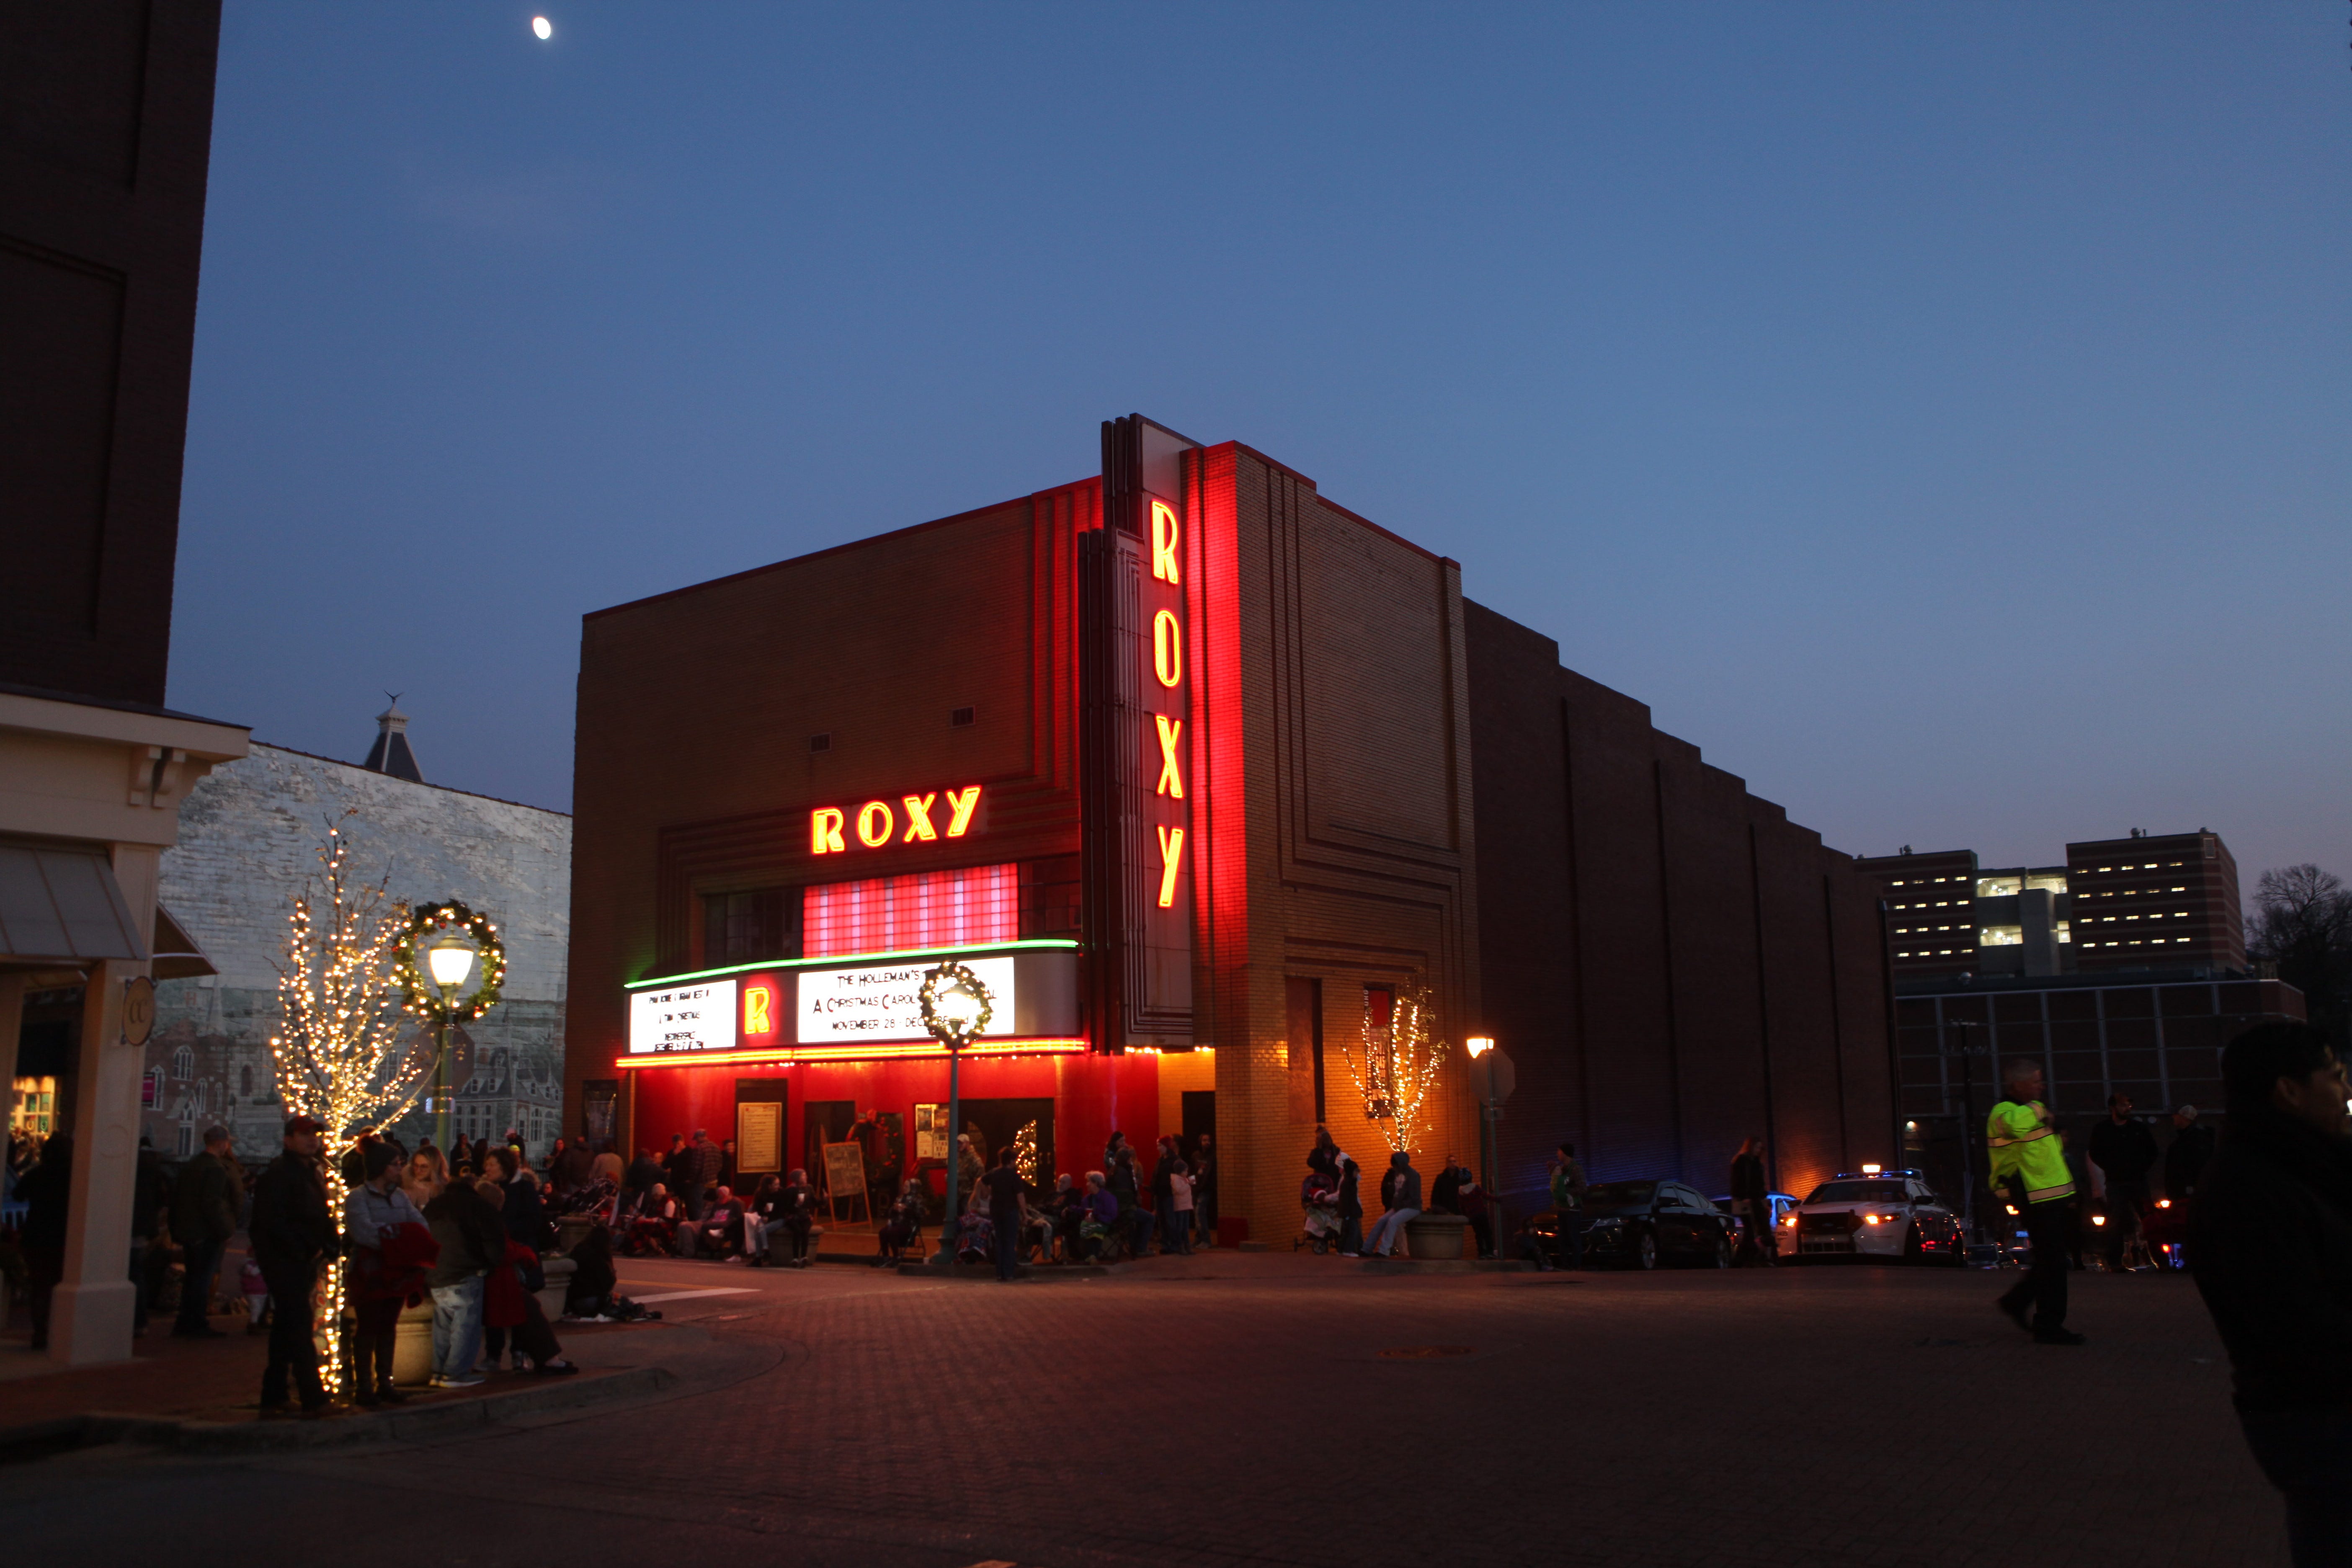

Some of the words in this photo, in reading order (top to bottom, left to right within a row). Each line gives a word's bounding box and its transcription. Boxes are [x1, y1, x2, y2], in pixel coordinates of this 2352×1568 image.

[1150, 498, 1184, 908] ROXY
[812, 784, 982, 855] ROXY
[838, 975, 854, 988] THE
[859, 970, 919, 987] HOLLEMAN'S
[745, 987, 771, 1035] R
[813, 999, 822, 1014] A
[827, 997, 879, 1012] CHRISTMAS
[882, 994, 916, 1009] CAROL
[833, 1019, 879, 1030] NOVEMBER
[884, 1019, 895, 1028] 28
